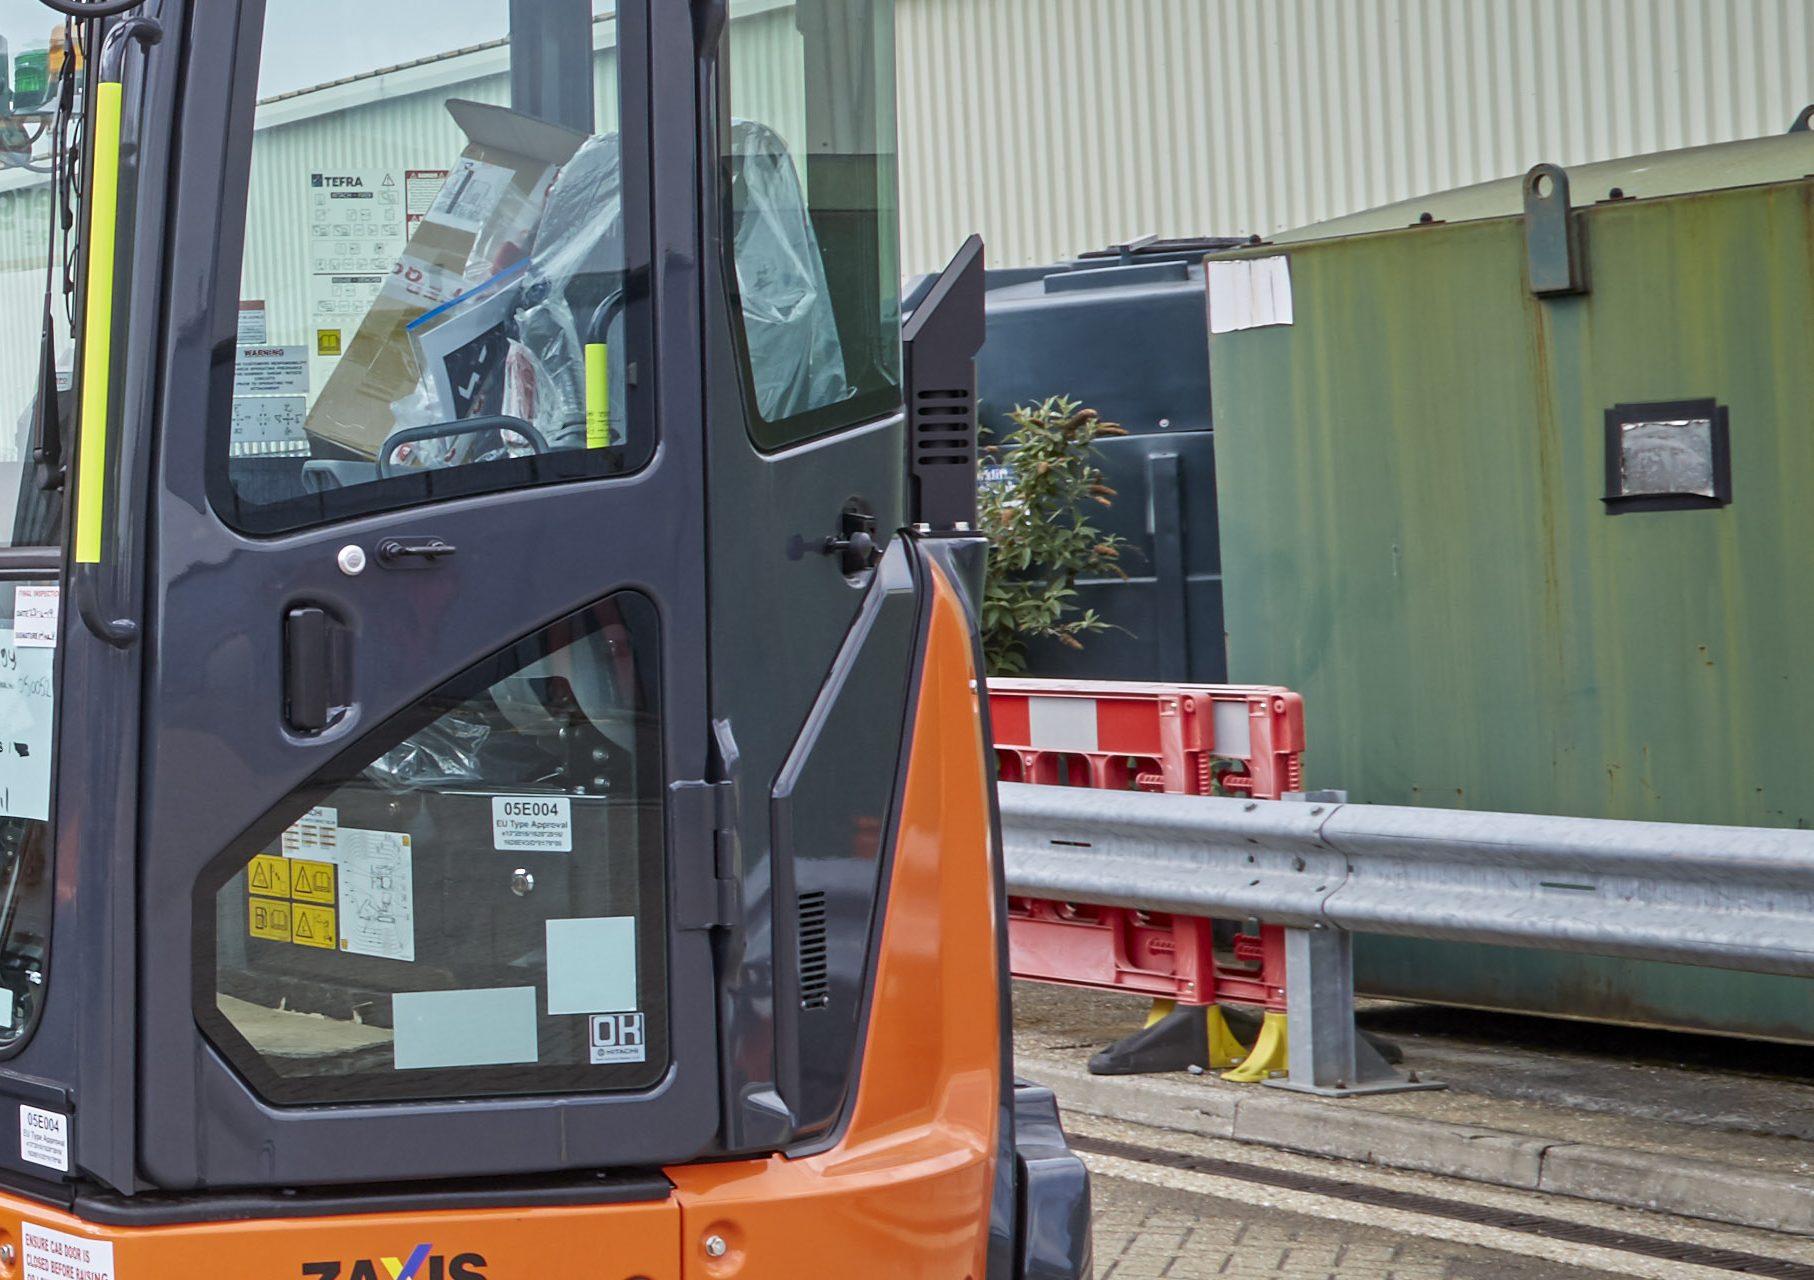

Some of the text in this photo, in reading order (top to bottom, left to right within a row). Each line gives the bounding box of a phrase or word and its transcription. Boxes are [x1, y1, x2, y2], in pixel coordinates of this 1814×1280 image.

[324, 176, 363, 187] TEFRA
[504, 802, 558, 816] 05E004
[510, 820, 529, 829] Type
[531, 820, 568, 829] Approval
[593, 1014, 641, 1047] OK
[28, 1112, 59, 1133] 05E004
[25, 1233, 91, 1263] ENSURE CAB DOOR IS
[26, 1254, 49, 1271] CLOSED
[51, 1260, 74, 1279] BEFORE
